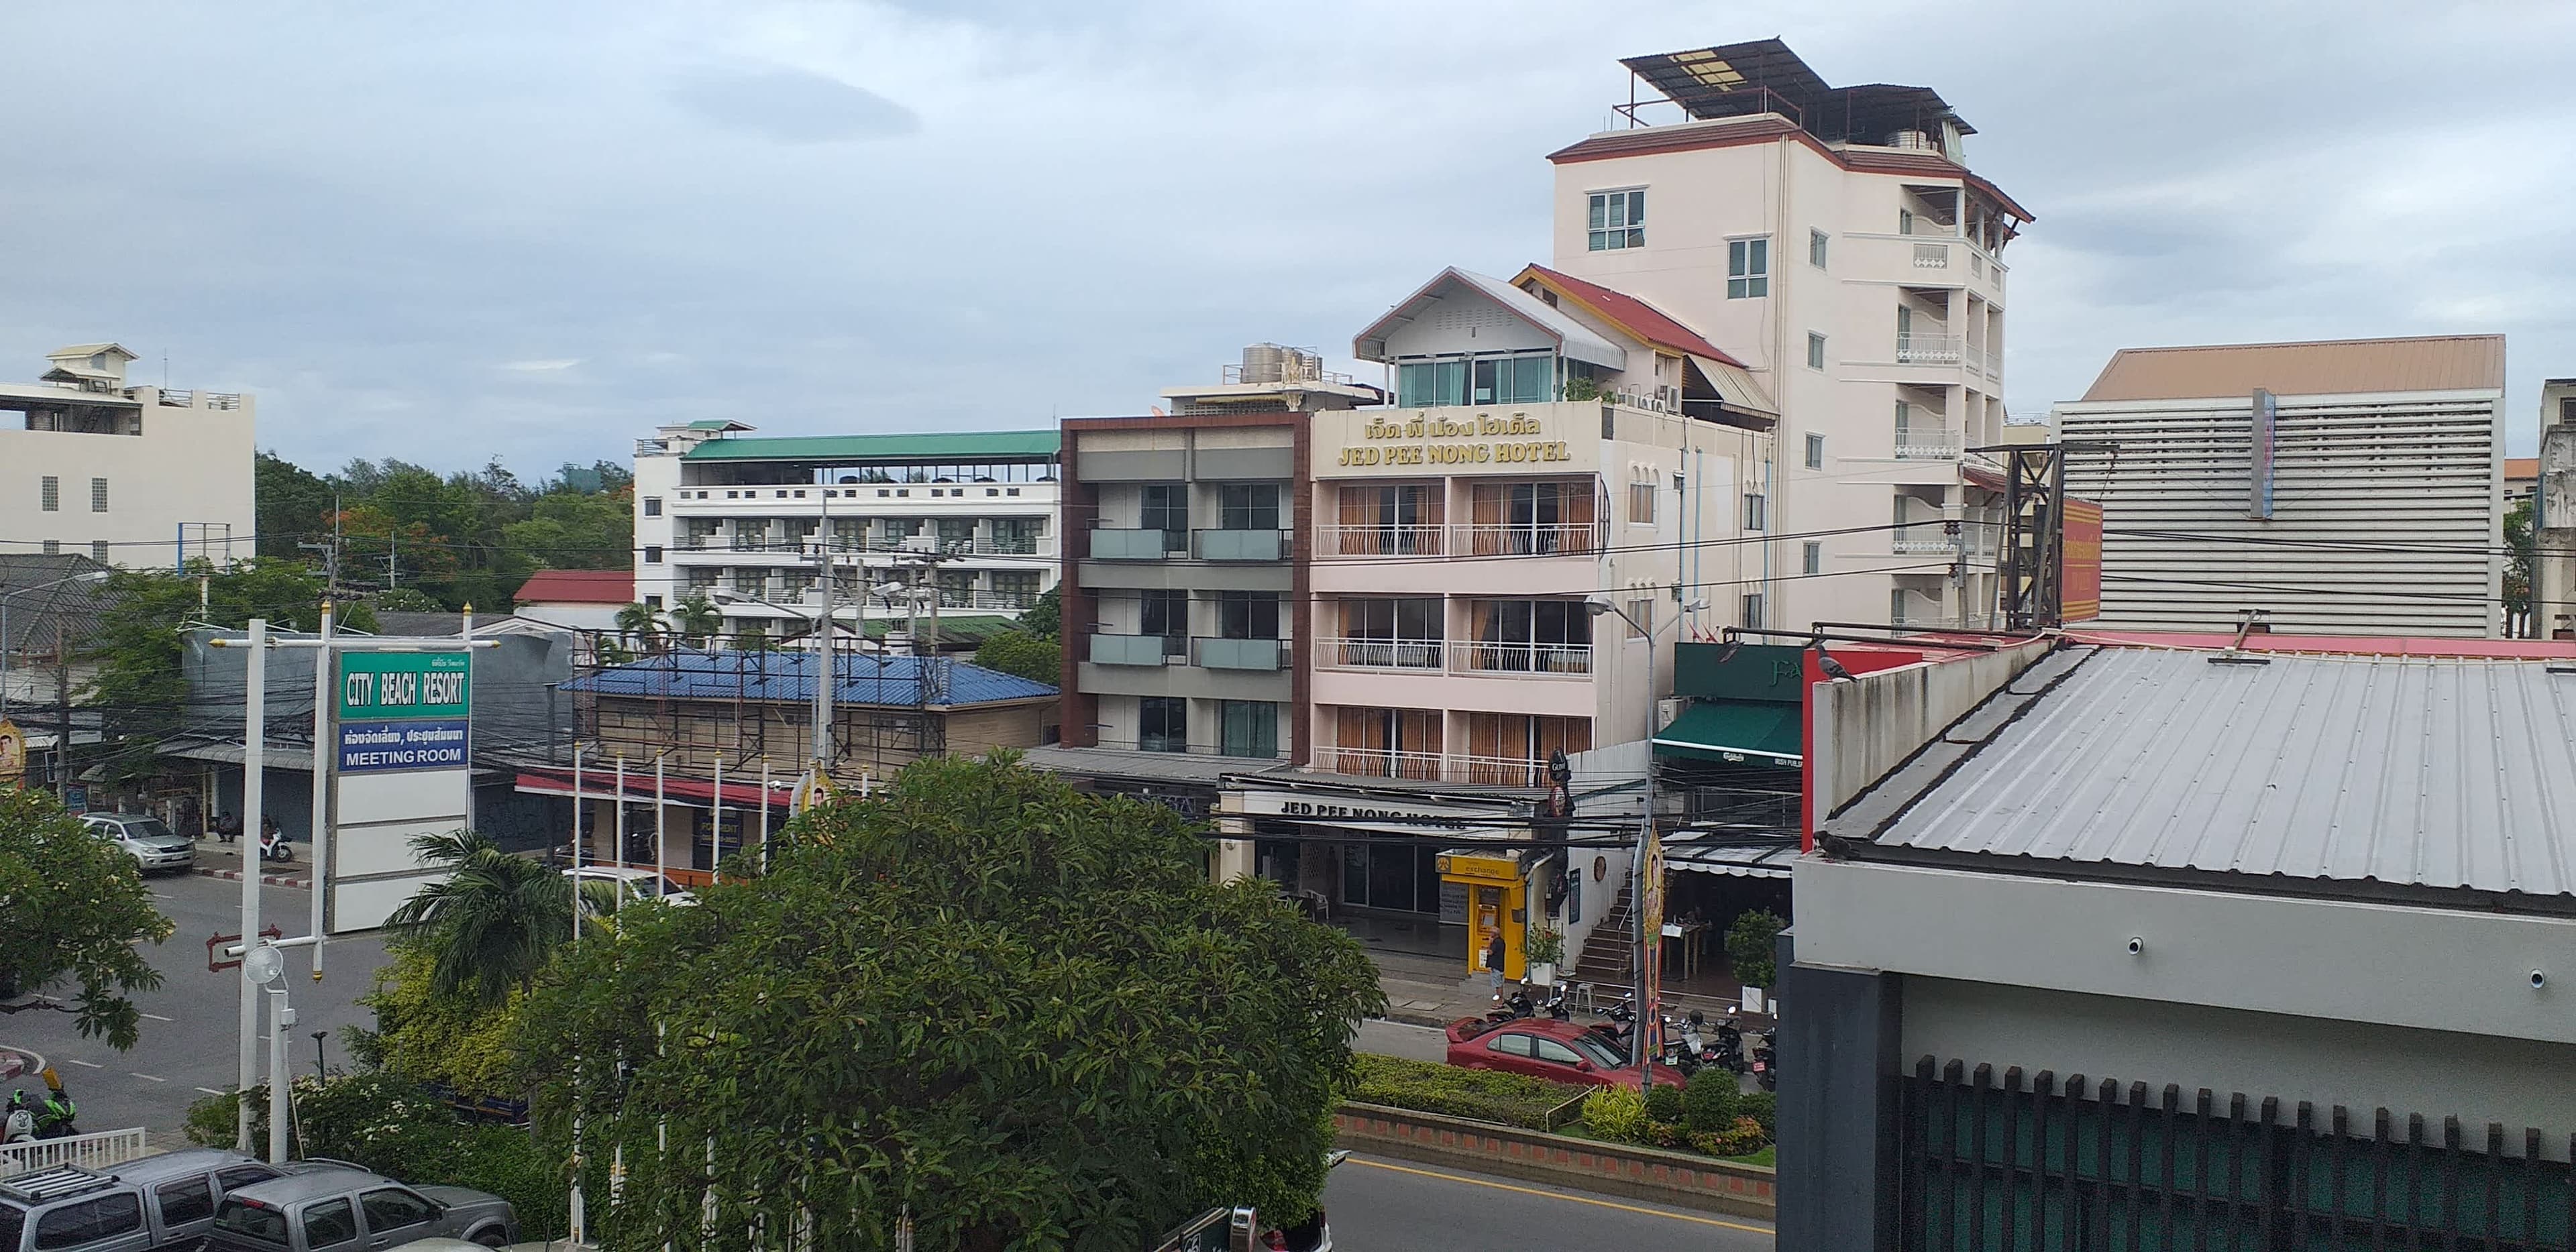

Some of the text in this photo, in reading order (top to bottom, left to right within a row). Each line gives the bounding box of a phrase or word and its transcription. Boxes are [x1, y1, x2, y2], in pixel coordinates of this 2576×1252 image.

[1477, 412, 1542, 435] โฮเต็ล
[1338, 441, 1571, 466] JED PEE NONG HOTEL
[346, 671, 465, 706] CITY BEACH RESORT
[345, 748, 462, 766] MEETING ROOM
[1281, 801, 1312, 815] JED
